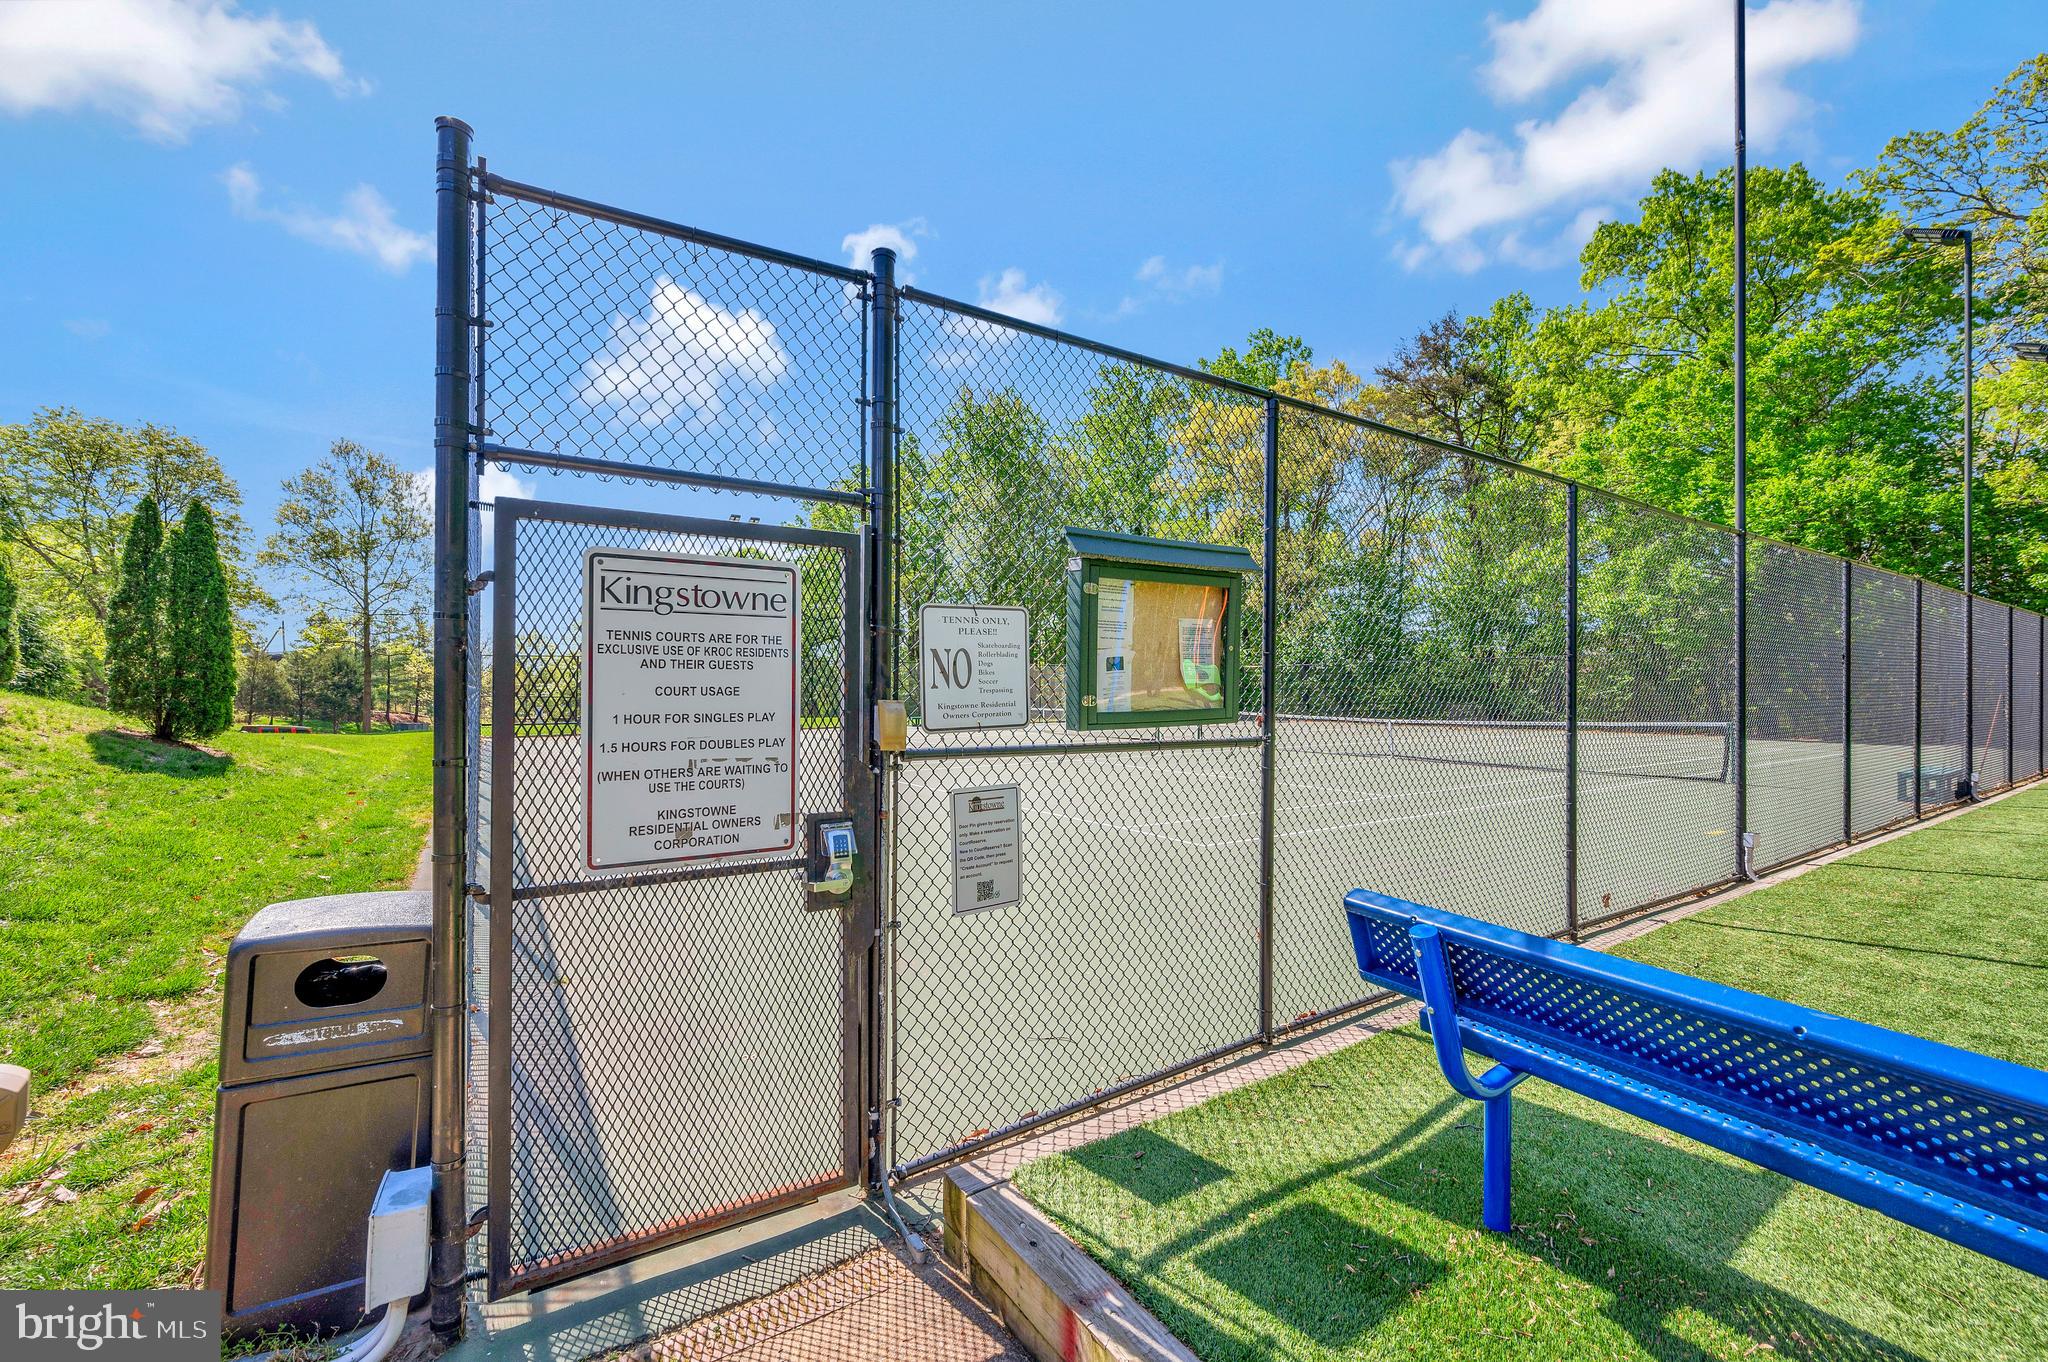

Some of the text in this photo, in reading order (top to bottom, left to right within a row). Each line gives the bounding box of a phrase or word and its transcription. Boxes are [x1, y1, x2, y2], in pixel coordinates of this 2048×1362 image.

[601, 576, 787, 615] Kingstowne
[982, 617, 1010, 625] ONLY,
[607, 630, 782, 645] TENNIS COURTS ARE FOR THE
[597, 644, 789, 658] EXCLUSIVE USE OF KROC RESIDENTS
[640, 659, 754, 670] AND THEIR GUESTS
[930, 648, 972, 689] NO
[655, 687, 740, 696] COURT USAGE
[613, 712, 776, 724] 1 HOUR FOR SINGLES PLAY
[600, 738, 785, 753] 1.5 HOURS FOR DOUBLES PLAY
[597, 763, 788, 784] (WHEN OTHERS ARE WAITING TO
[649, 779, 744, 793] USE THE COURTS)
[657, 805, 736, 820] KINGSTOWNE
[629, 817, 761, 836] RESIDENTIAL OWNERS
[654, 834, 740, 850] CORPORATION
